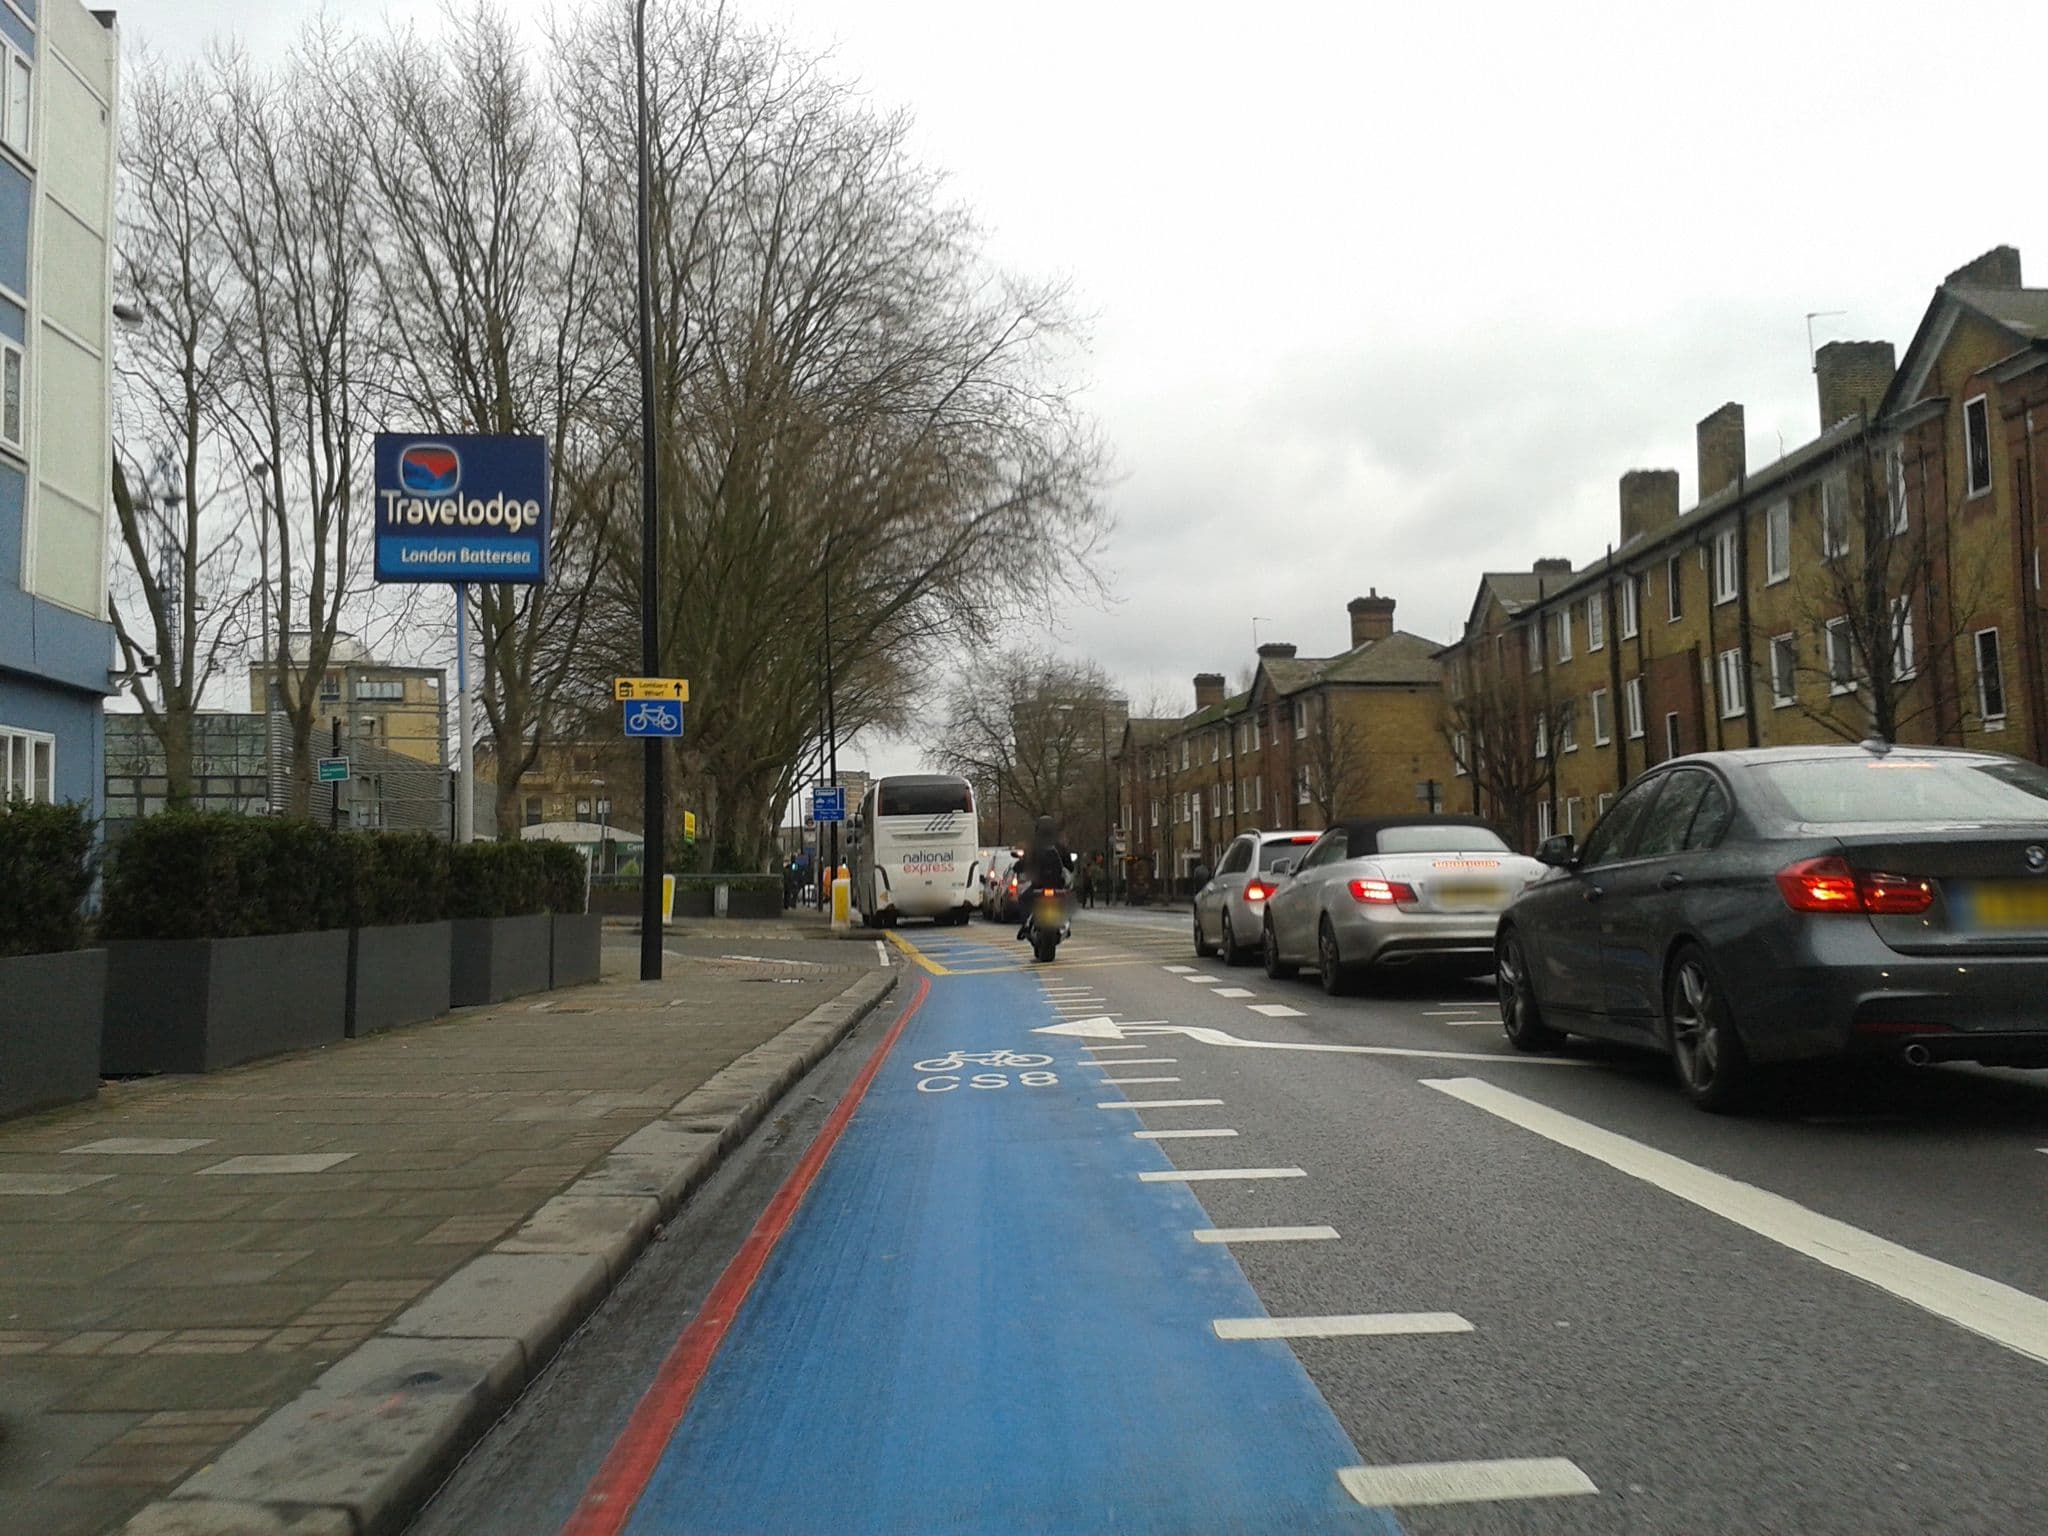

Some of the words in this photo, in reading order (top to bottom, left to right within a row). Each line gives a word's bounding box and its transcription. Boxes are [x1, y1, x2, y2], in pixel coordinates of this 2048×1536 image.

[380, 489, 540, 533] Travelodge
[401, 547, 456, 563] London
[460, 547, 531, 563] Battersea
[902, 849, 954, 863] national
[903, 863, 955, 876] express
[916, 1071, 1060, 1093] CS8
